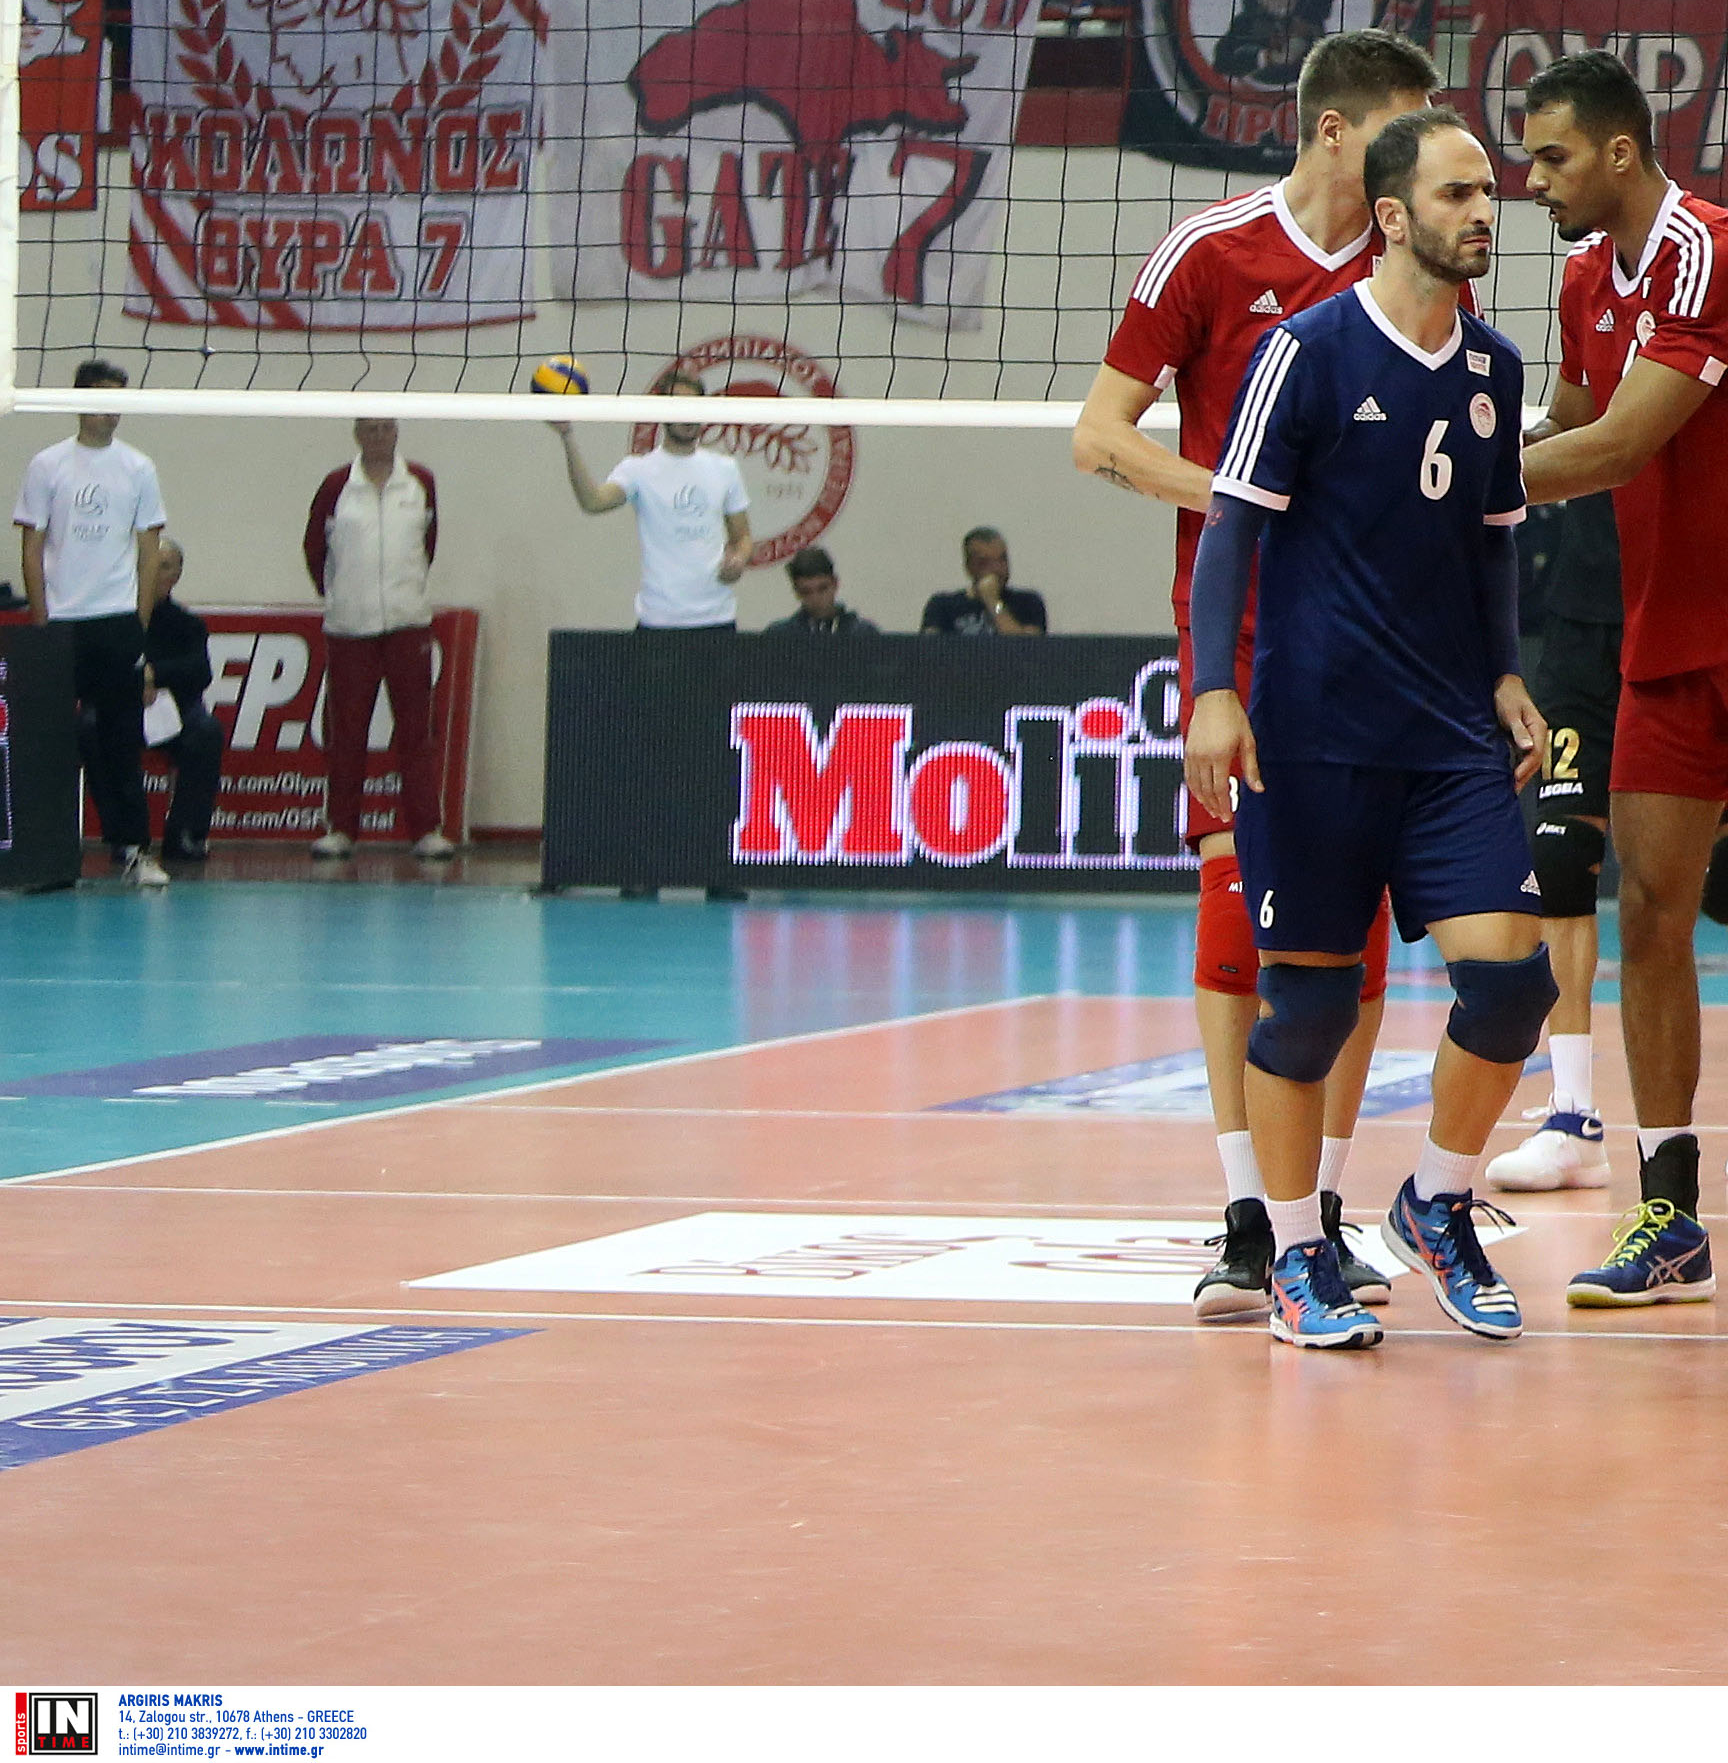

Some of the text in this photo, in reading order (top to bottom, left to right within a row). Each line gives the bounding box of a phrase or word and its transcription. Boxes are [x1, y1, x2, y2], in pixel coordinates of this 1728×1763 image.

[144, 108, 527, 196] ΚΟΛΩΝΟΣ
[198, 210, 468, 301] ΘΥΡΑ 7
[619, 138, 992, 307] GATE 7
[1353, 413, 1387, 421] adidas
[1420, 420, 1453, 500] 6
[1539, 782, 1584, 799] LEGEA
[1541, 727, 1580, 781] 12
[1259, 890, 1275, 929] 6
[17, 1330, 493, 1431] ΘΕΣΣΑΛΟΝΙΚΗ
